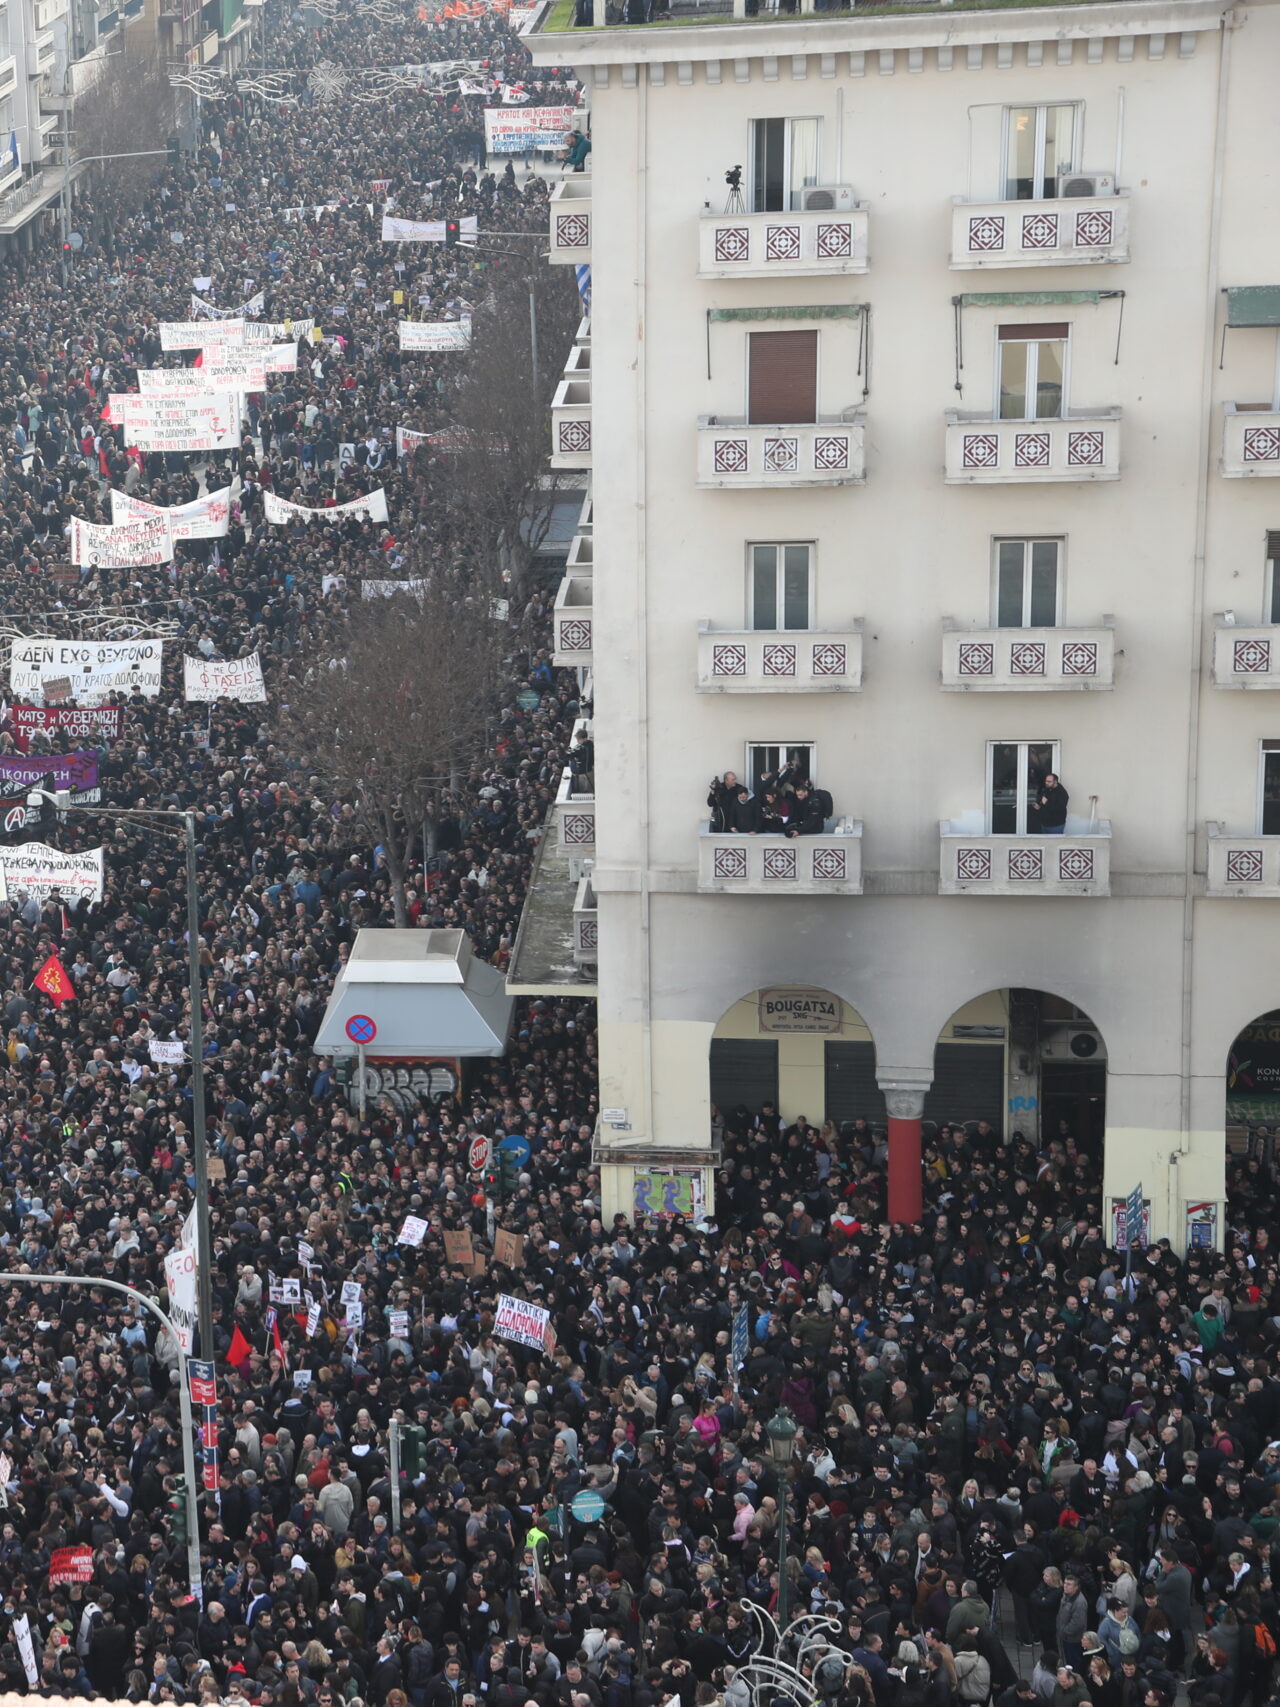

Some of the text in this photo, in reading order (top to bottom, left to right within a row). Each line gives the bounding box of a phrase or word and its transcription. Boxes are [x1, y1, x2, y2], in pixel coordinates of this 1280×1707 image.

[228, 654, 260, 674] ΟΤΑΝ
[15, 672, 38, 688] ΑΥΤΟ
[84, 673, 113, 687] ΚΡΑΤΟΣ
[18, 709, 46, 723] ΚΑΤΩ
[58, 709, 119, 724] ΚΥΒΕΡΝΗΣΗ
[766, 1001, 836, 1017] BOUGATSA
[471, 1143, 489, 1166] STOP
[501, 1296, 545, 1320] ΤΗΝ ΚΡΑΤΙΚΗ
[497, 1308, 544, 1339] ΔΟΛΟΦΟΝΙΑ
